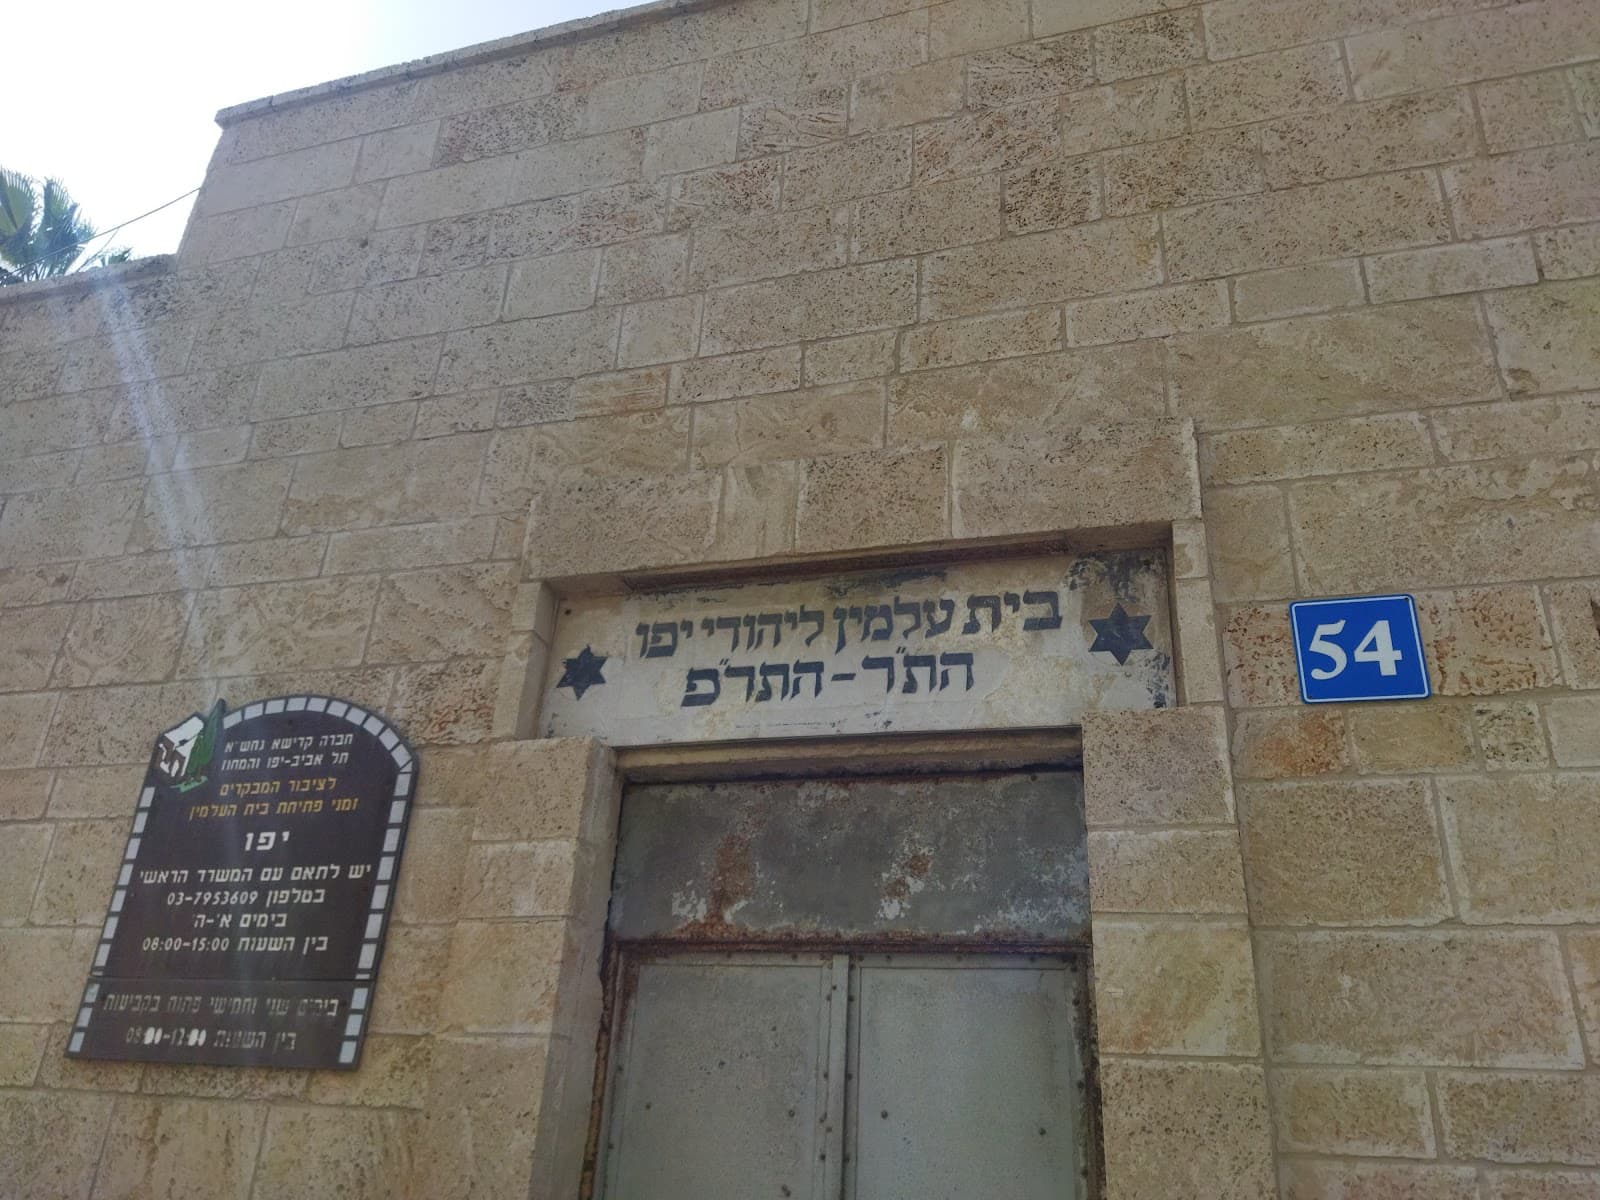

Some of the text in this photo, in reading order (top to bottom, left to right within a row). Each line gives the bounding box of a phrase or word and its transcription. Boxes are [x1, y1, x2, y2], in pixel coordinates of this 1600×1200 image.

[635, 590, 1063, 659] בית עלמין ליהודי יפו
[1309, 619, 1402, 680] 54
[271, 737, 315, 750] קדישא
[320, 734, 354, 747] חברה
[221, 750, 350, 771] תל אביב-יפו והמחוז
[220, 777, 337, 797] לציבור המבקרים
[188, 797, 360, 821] זמני פתיחת בית העלמין
[244, 831, 290, 851] יפו
[139, 863, 372, 884] יש לתאם עם המשרד הראשי
[167, 887, 326, 907] בטלפון 03-7953609
[239, 913, 288, 929] בימים
[142, 936, 329, 955] בין השעות 08:00-15:00
